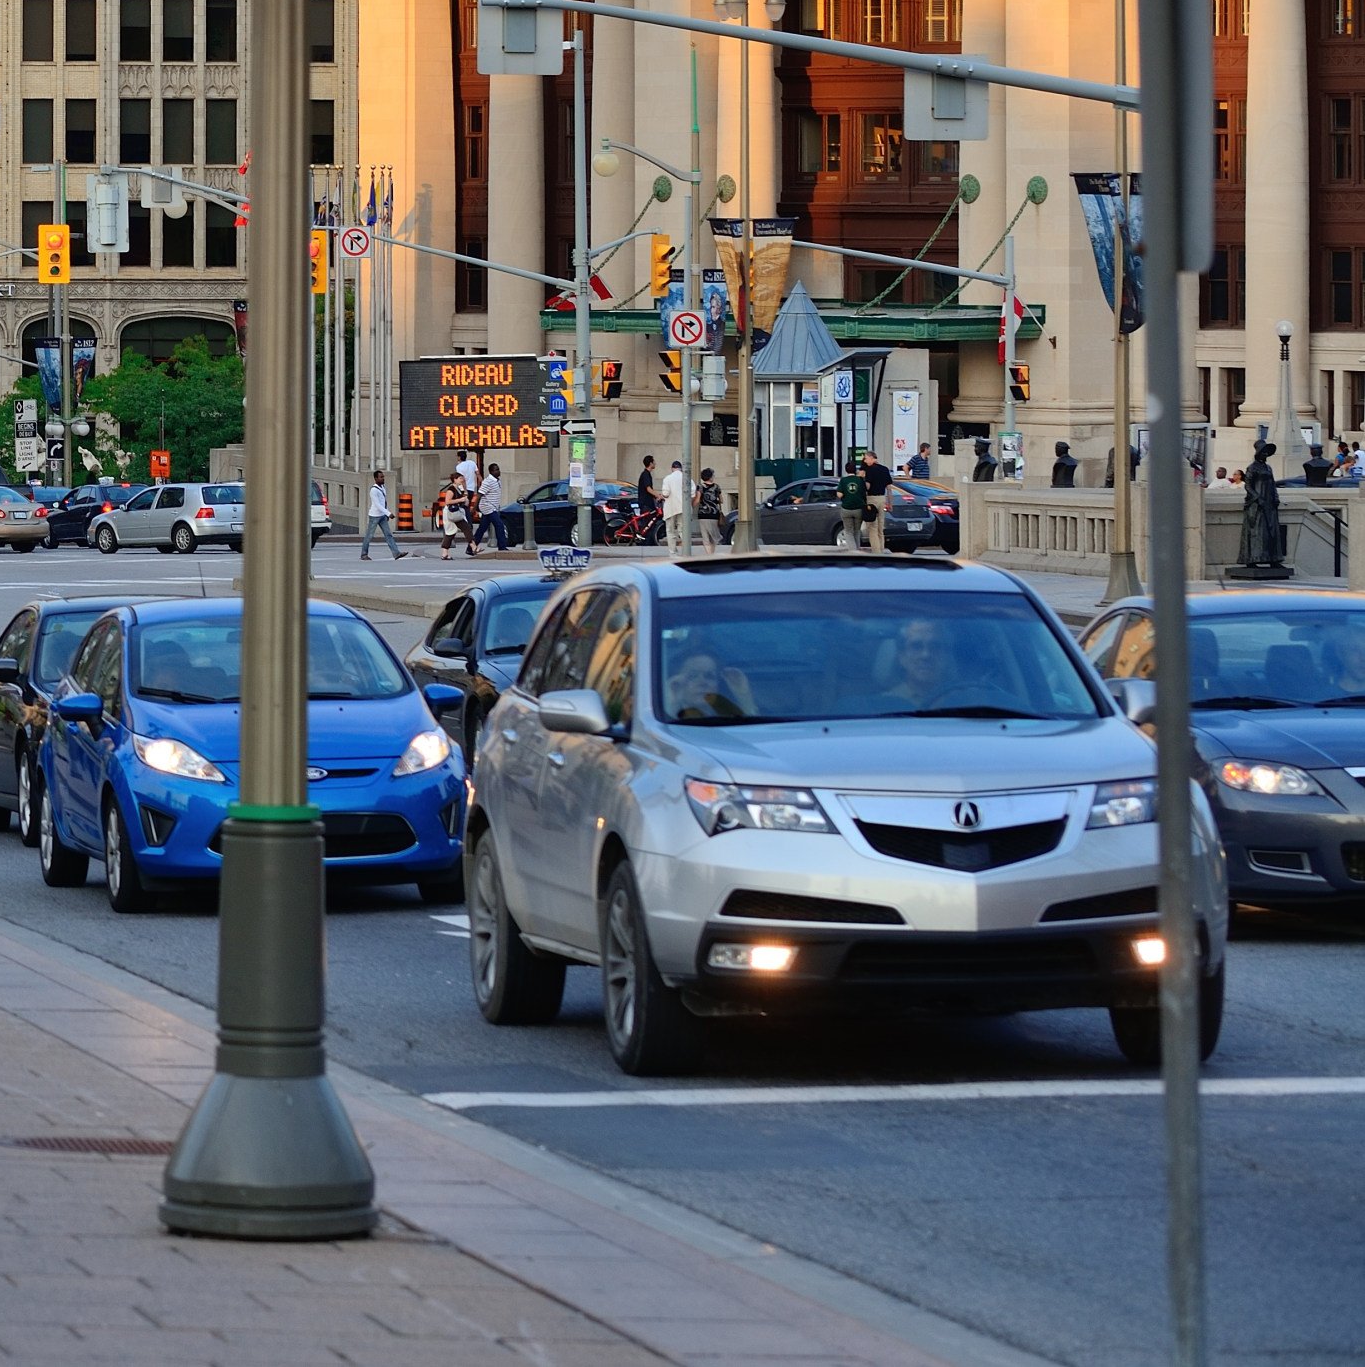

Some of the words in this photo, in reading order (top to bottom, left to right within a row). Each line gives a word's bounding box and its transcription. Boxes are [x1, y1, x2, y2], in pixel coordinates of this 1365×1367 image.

[441, 363, 513, 386] RIDEAU
[439, 394, 519, 417] CLOSED
[410, 426, 440, 448] AT
[445, 425, 547, 448] NICHOLAS
[543, 555, 567, 566] BLUE
[567, 555, 589, 566] LINE
